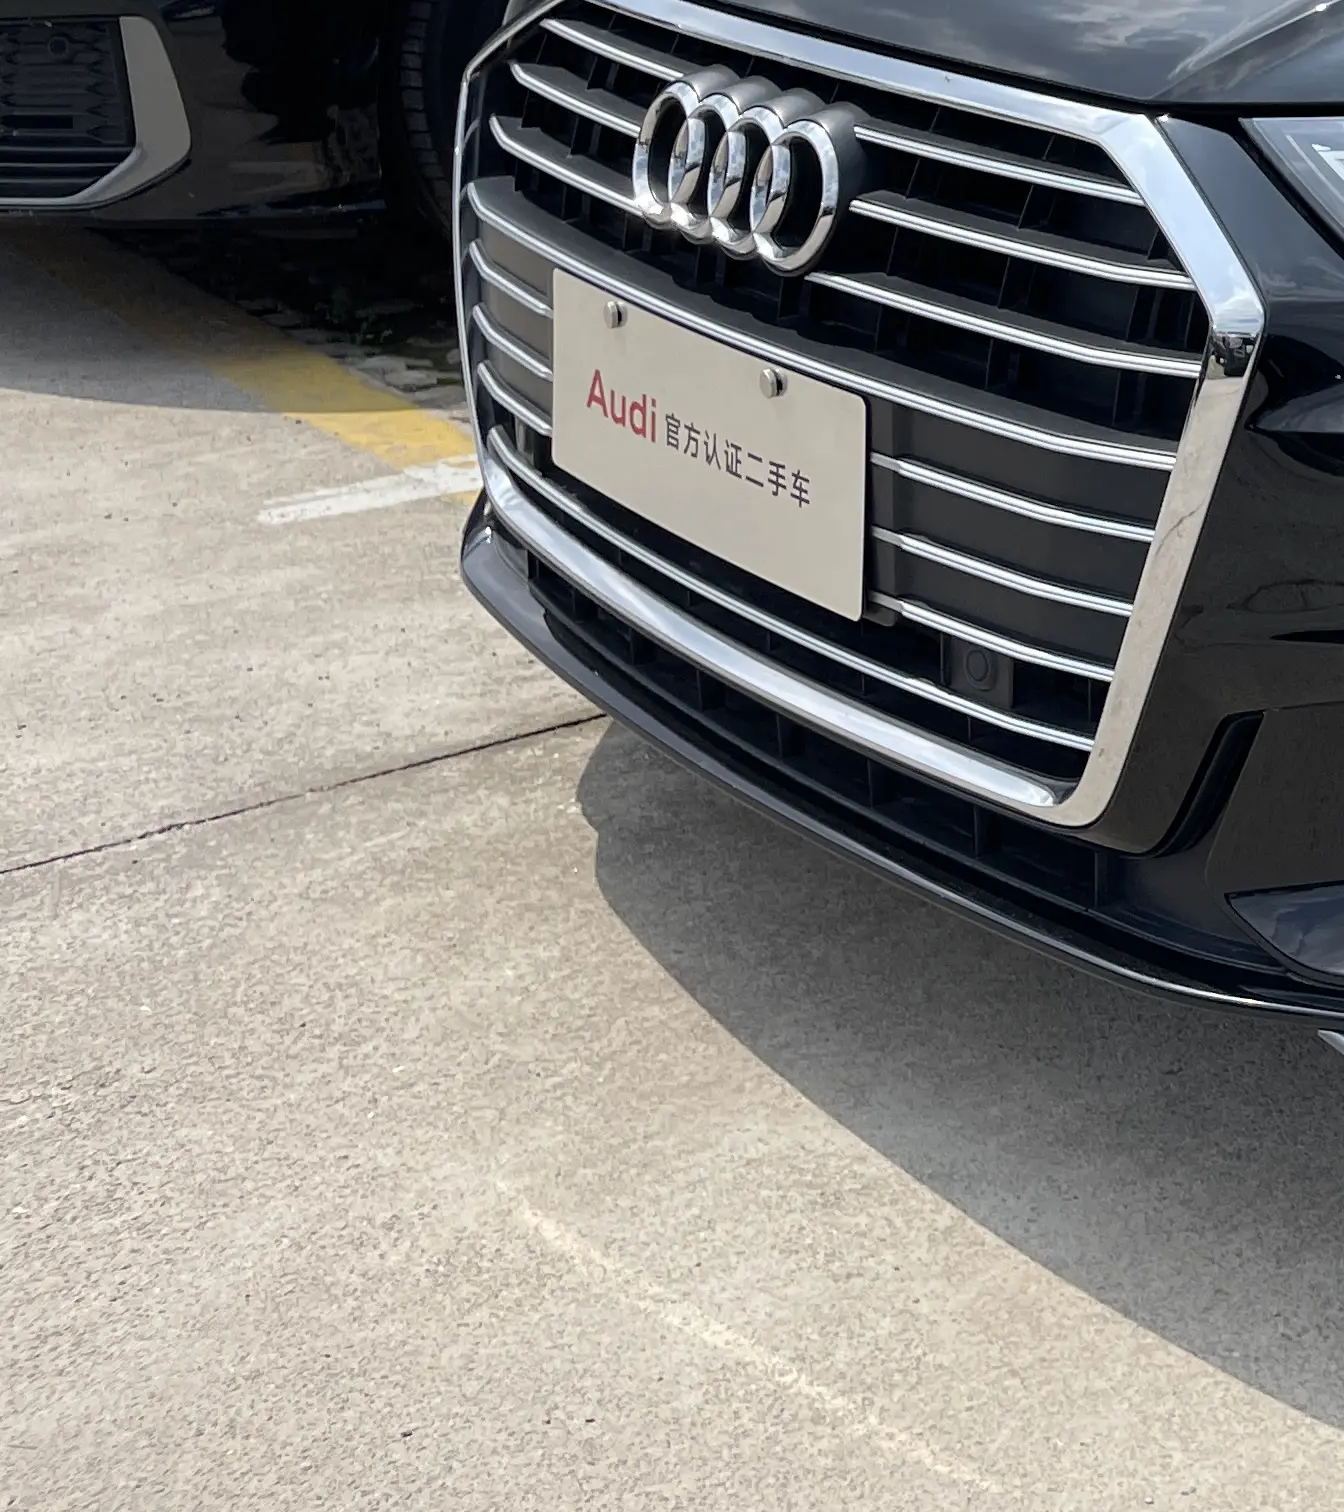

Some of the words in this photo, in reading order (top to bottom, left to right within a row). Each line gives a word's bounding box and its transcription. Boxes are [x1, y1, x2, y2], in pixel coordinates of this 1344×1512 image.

[586, 368, 657, 444] Audi
[664, 412, 811, 508] 官方认证二手车
